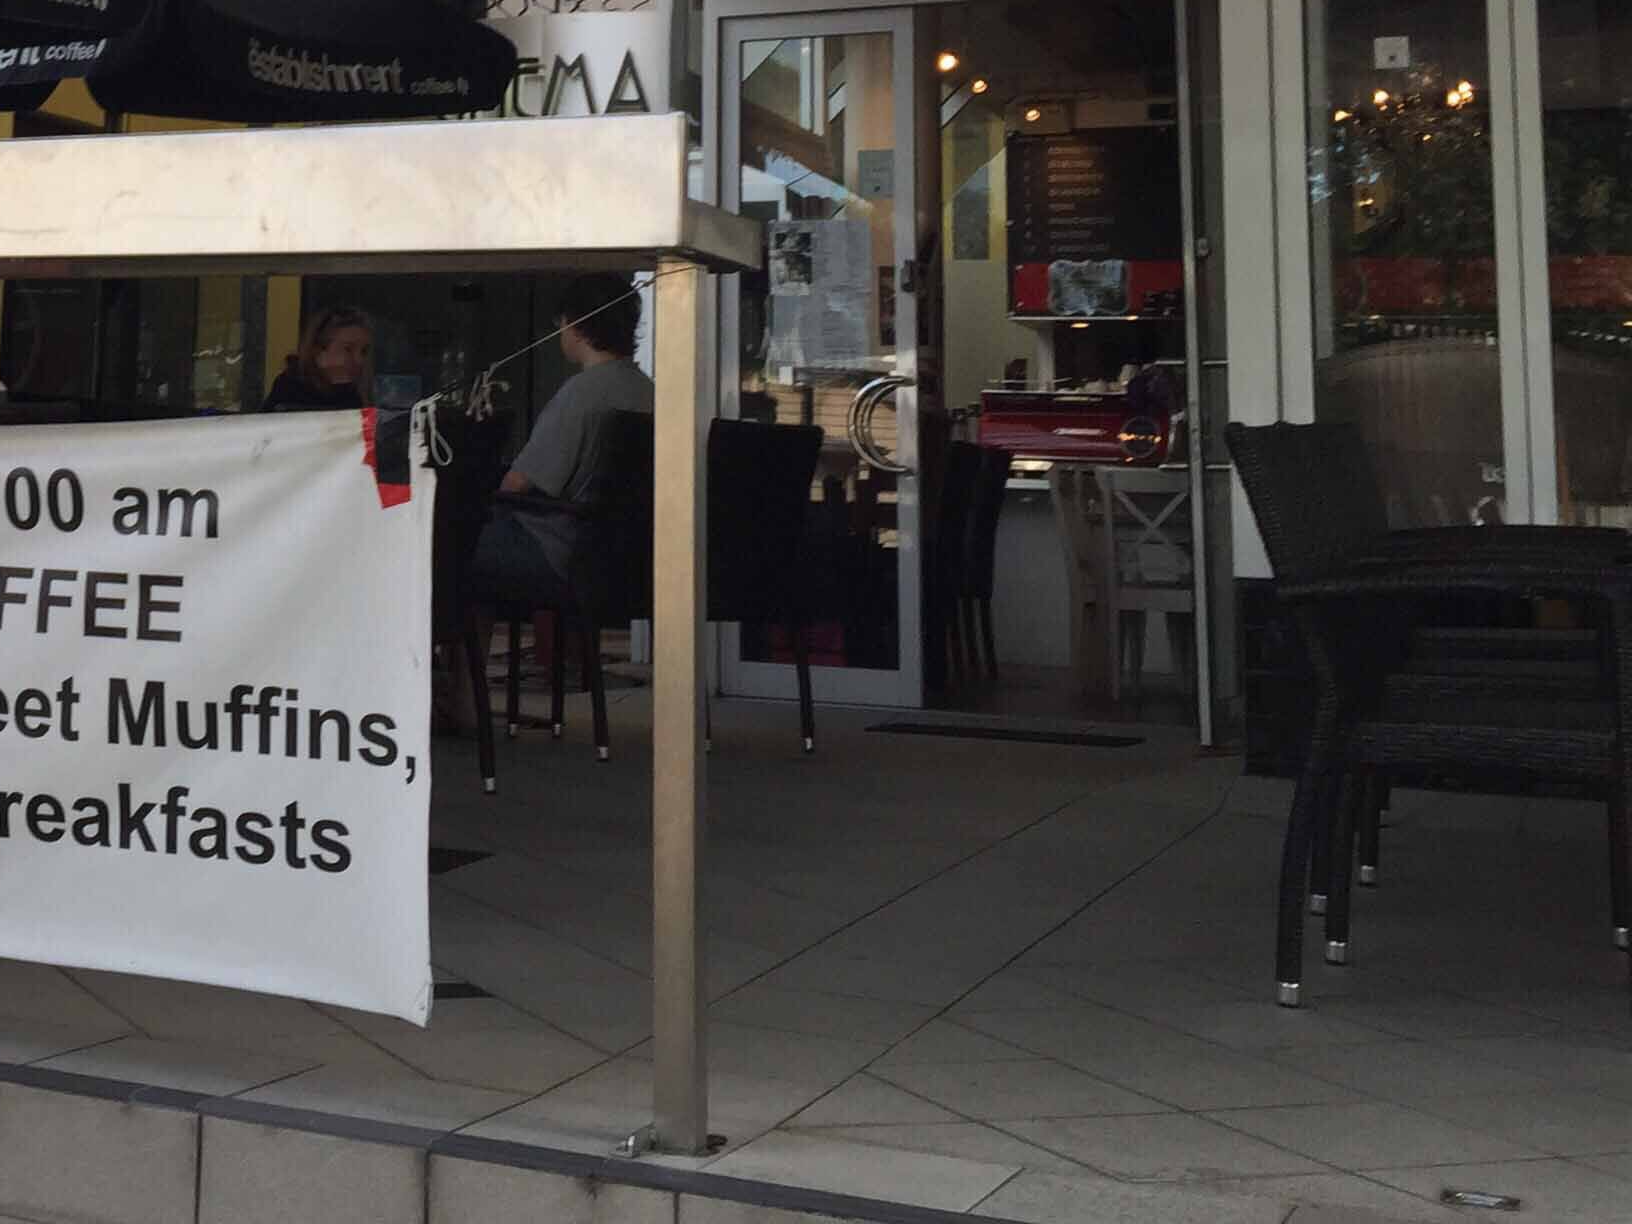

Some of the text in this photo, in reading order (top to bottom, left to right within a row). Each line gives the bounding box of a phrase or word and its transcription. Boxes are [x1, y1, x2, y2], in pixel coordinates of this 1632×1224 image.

[44, 40, 96, 62] coffee
[113, 486, 221, 540] am
[107, 677, 419, 785] Muffins,
